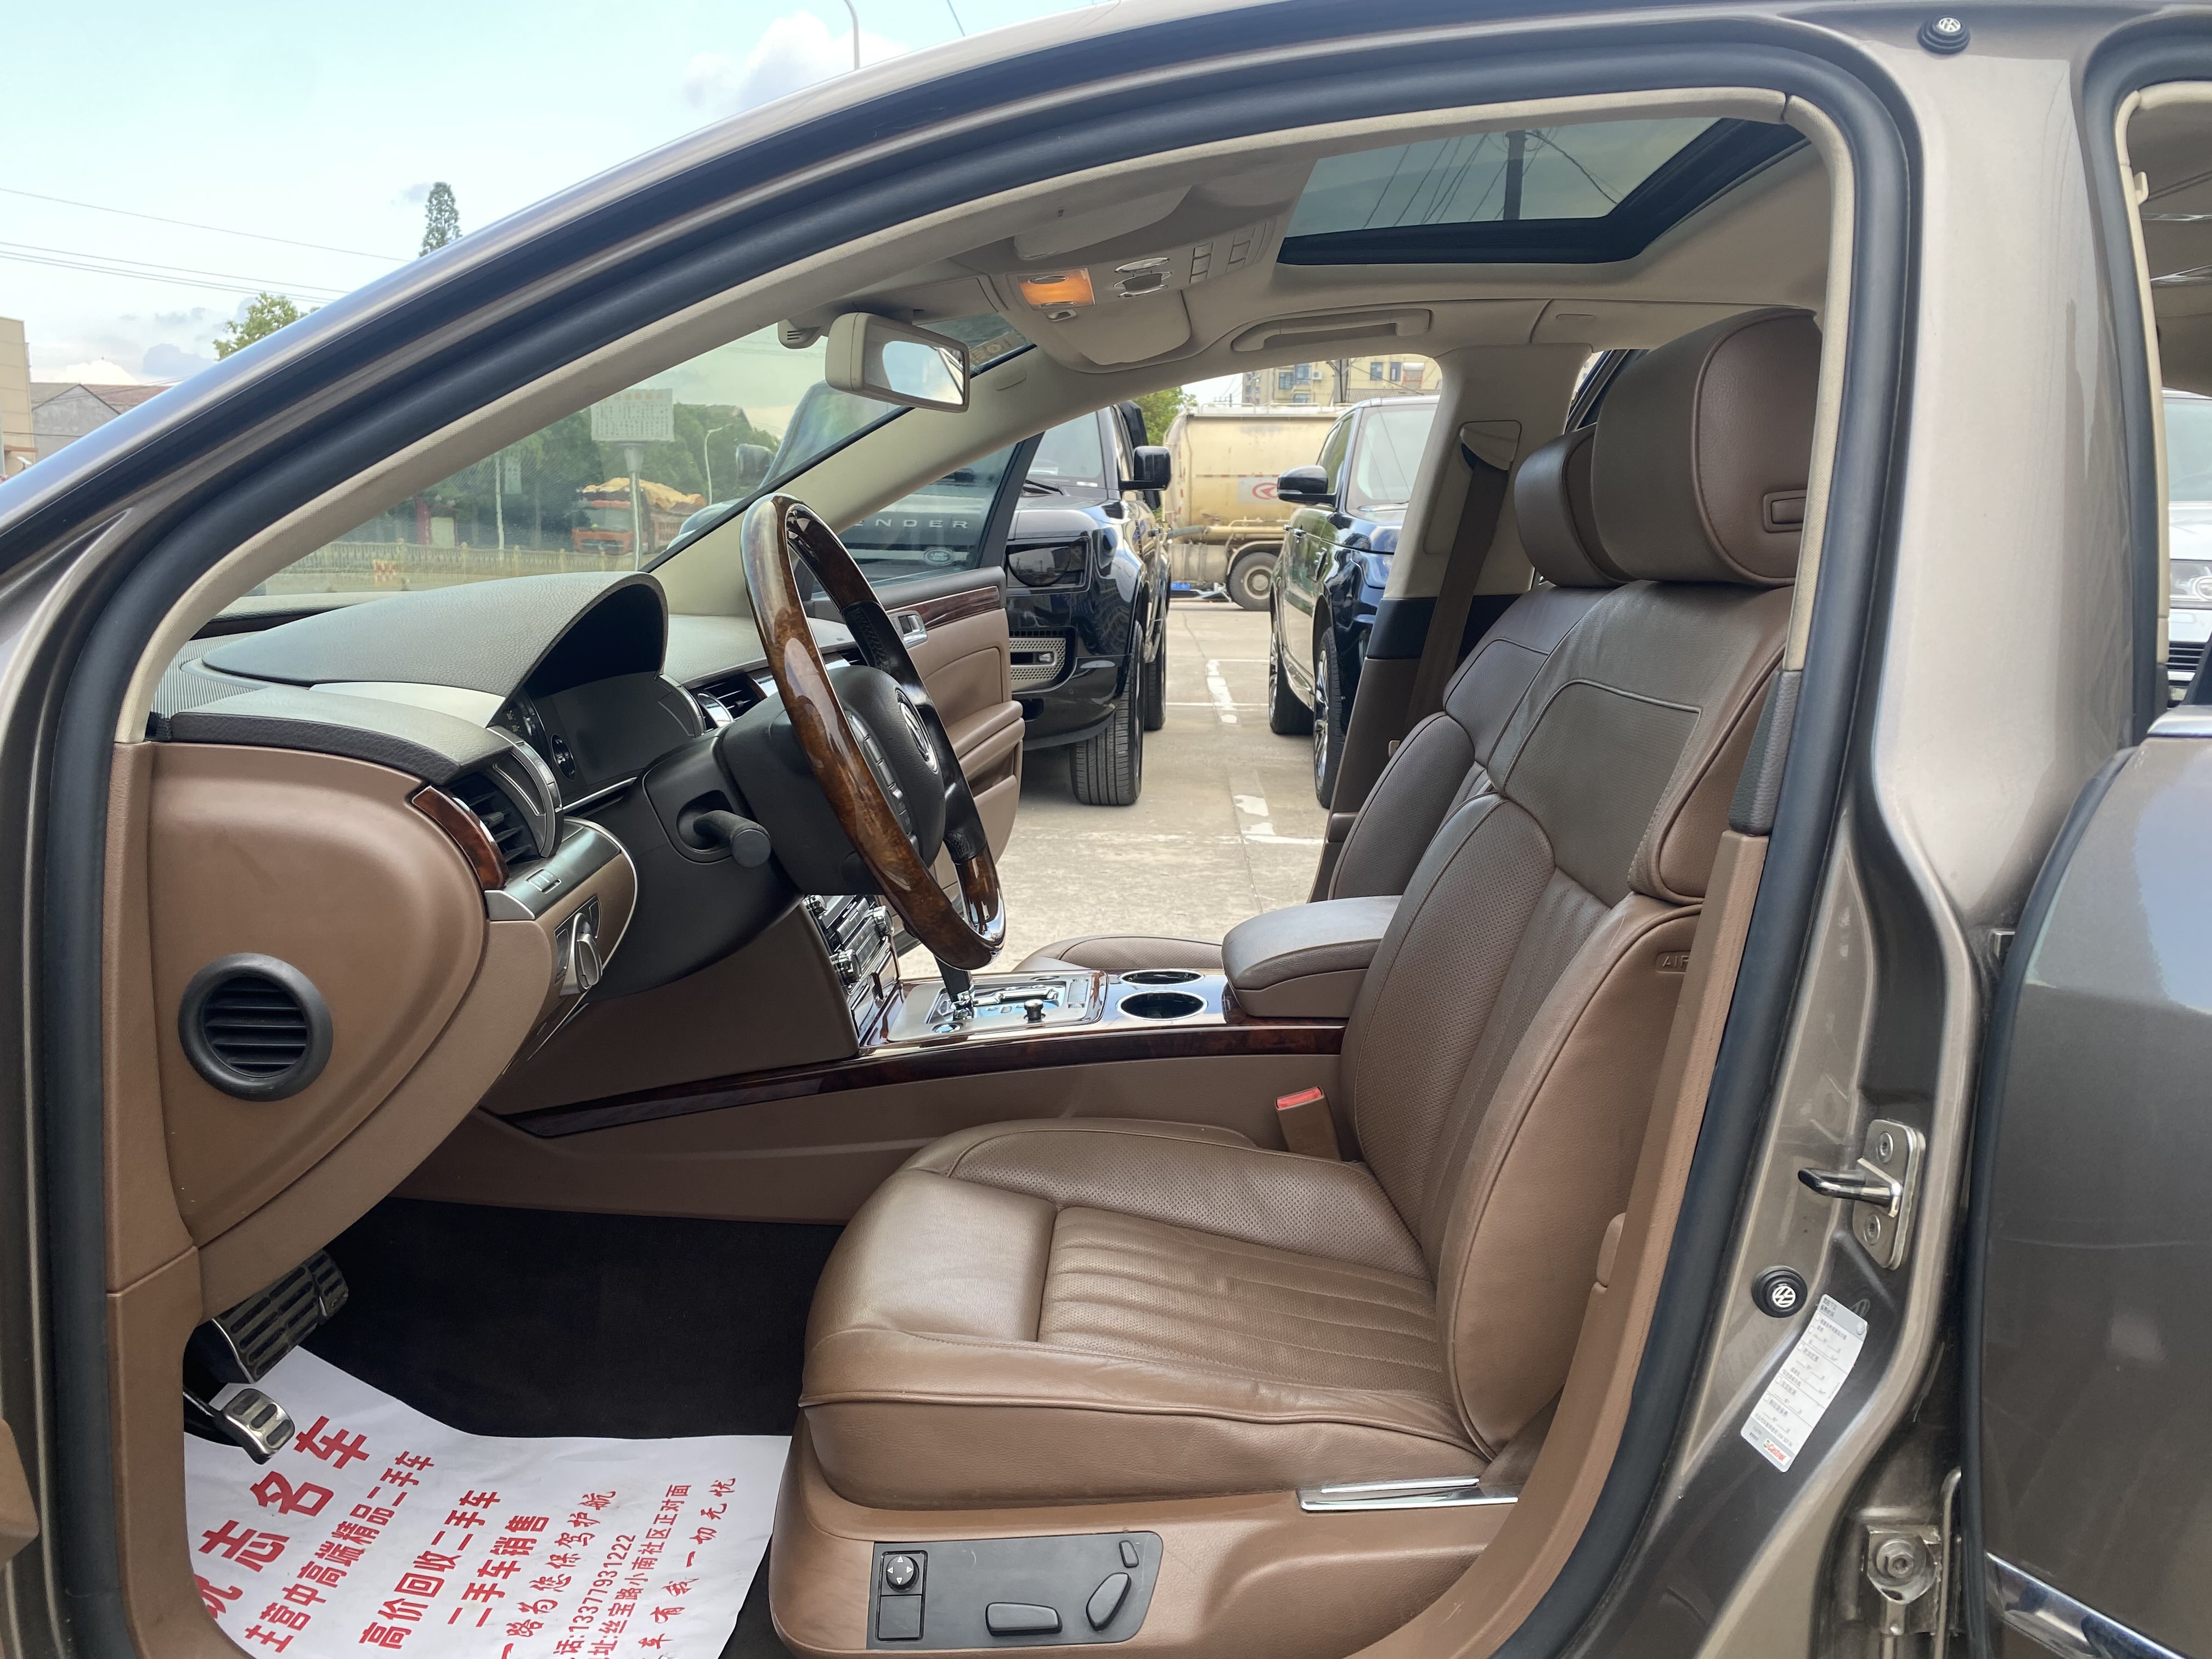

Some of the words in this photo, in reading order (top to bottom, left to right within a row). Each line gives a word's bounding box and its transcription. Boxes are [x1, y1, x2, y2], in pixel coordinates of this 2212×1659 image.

[245, 1451, 435, 1654] 主营中高端精品二手车
[358, 1489, 501, 1650] 高价回收二手车
[447, 1515, 550, 1628] 二手车销售
[553, 1534, 636, 1659] 话:13377931222
